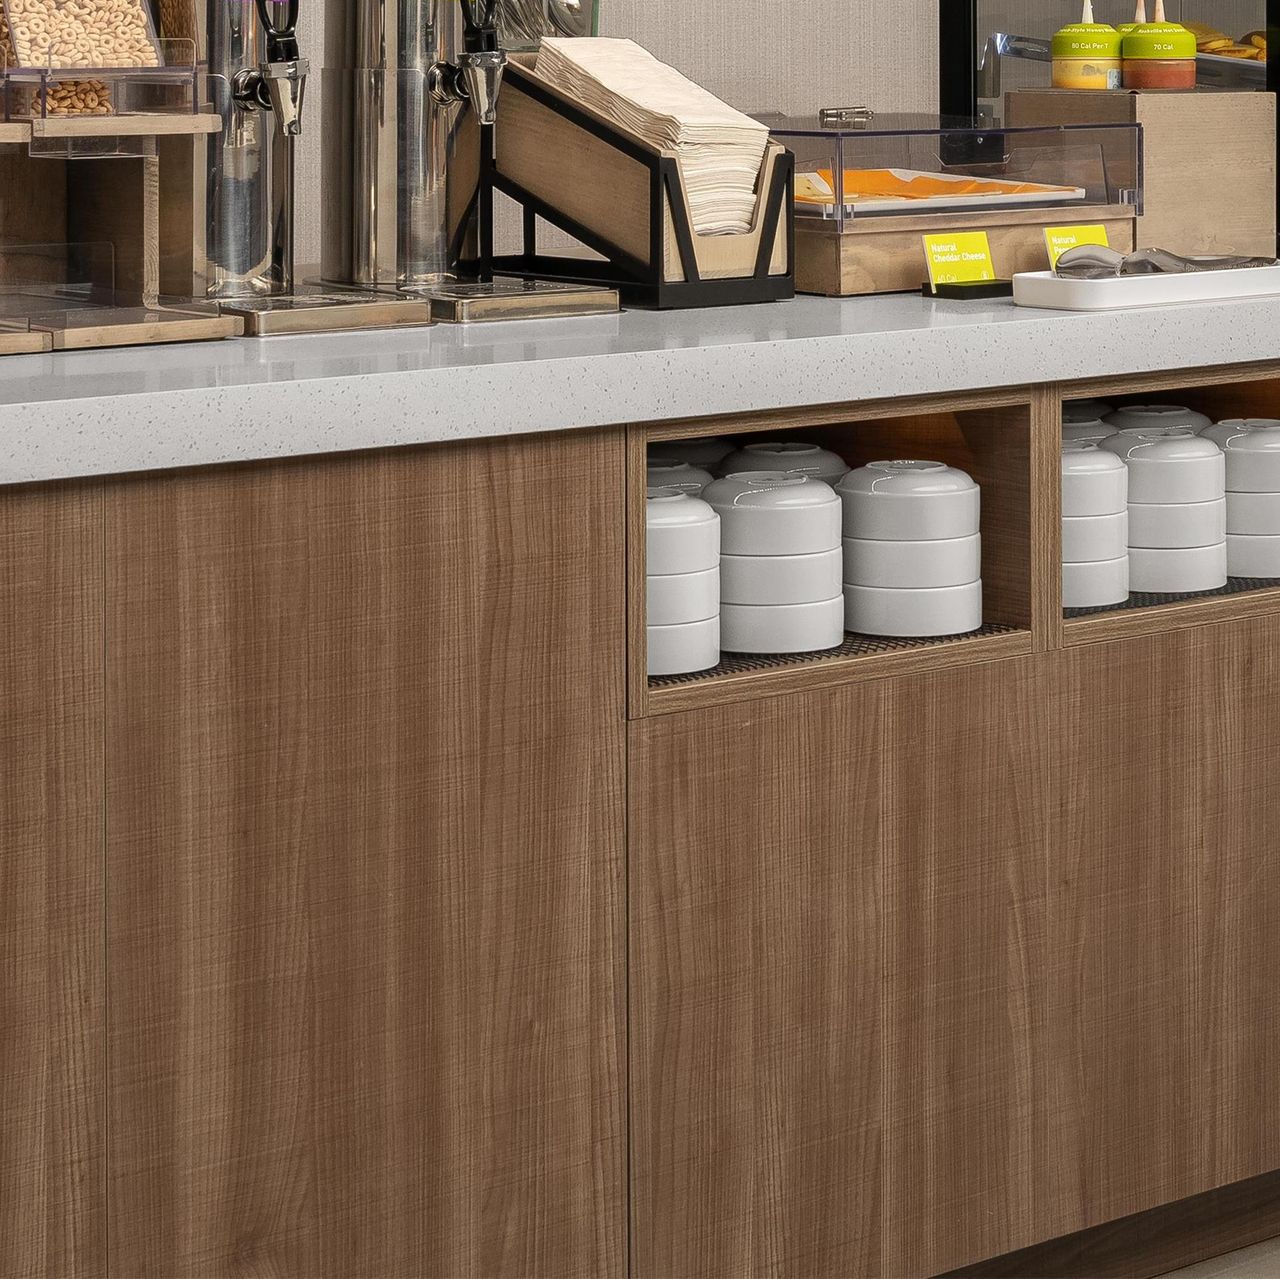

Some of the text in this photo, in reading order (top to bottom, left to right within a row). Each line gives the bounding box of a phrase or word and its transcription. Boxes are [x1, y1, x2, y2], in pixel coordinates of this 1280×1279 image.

[1051, 234, 1077, 244] Natural
[931, 243, 957, 253] Natural
[934, 252, 986, 263] Cheddar Cheese
